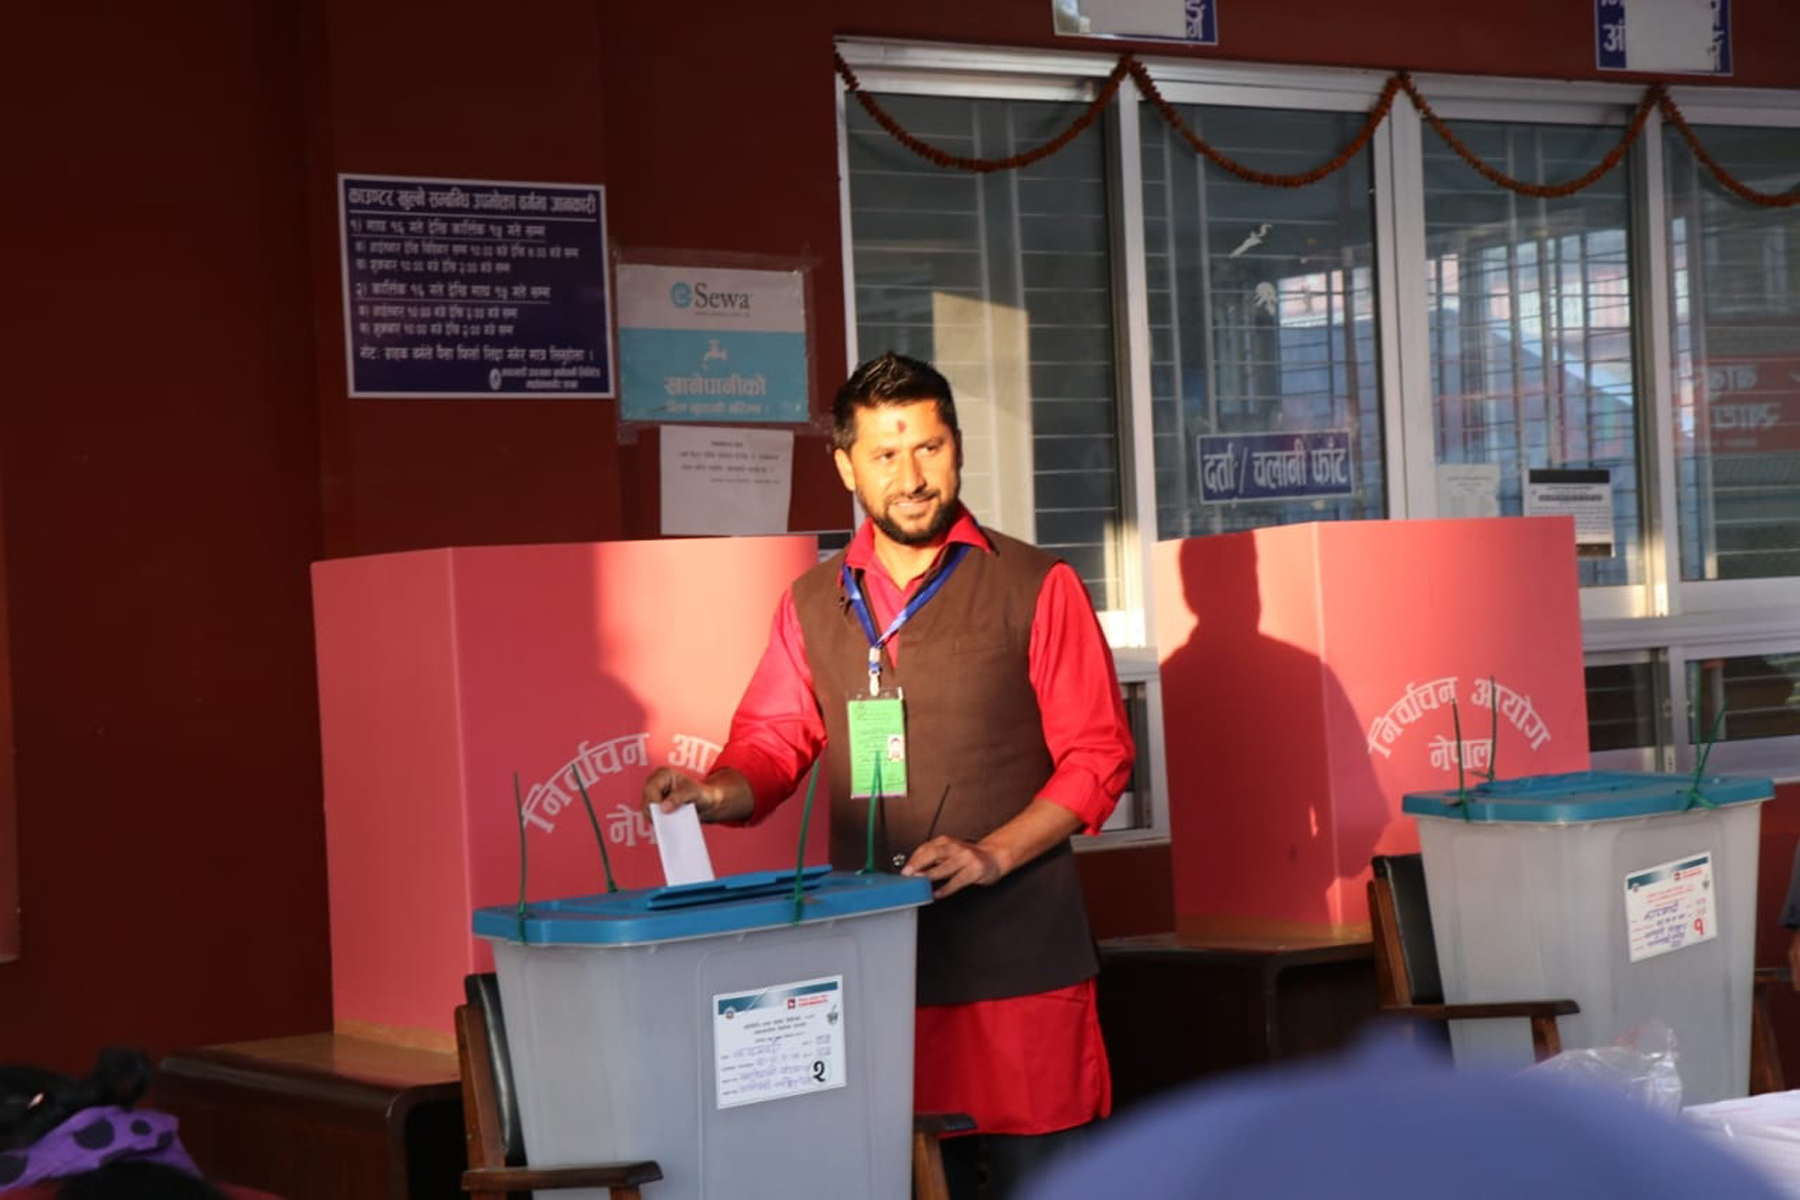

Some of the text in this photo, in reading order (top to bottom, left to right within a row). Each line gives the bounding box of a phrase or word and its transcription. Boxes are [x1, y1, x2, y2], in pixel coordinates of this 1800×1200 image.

[1252, 438, 1307, 489] चलानी
[1368, 676, 1552, 758] निर्वाचन आयोग
[1429, 735, 1492, 770] नेपाल
[521, 732, 650, 833] निर्वाचन
[813, 1060, 825, 1083] २
